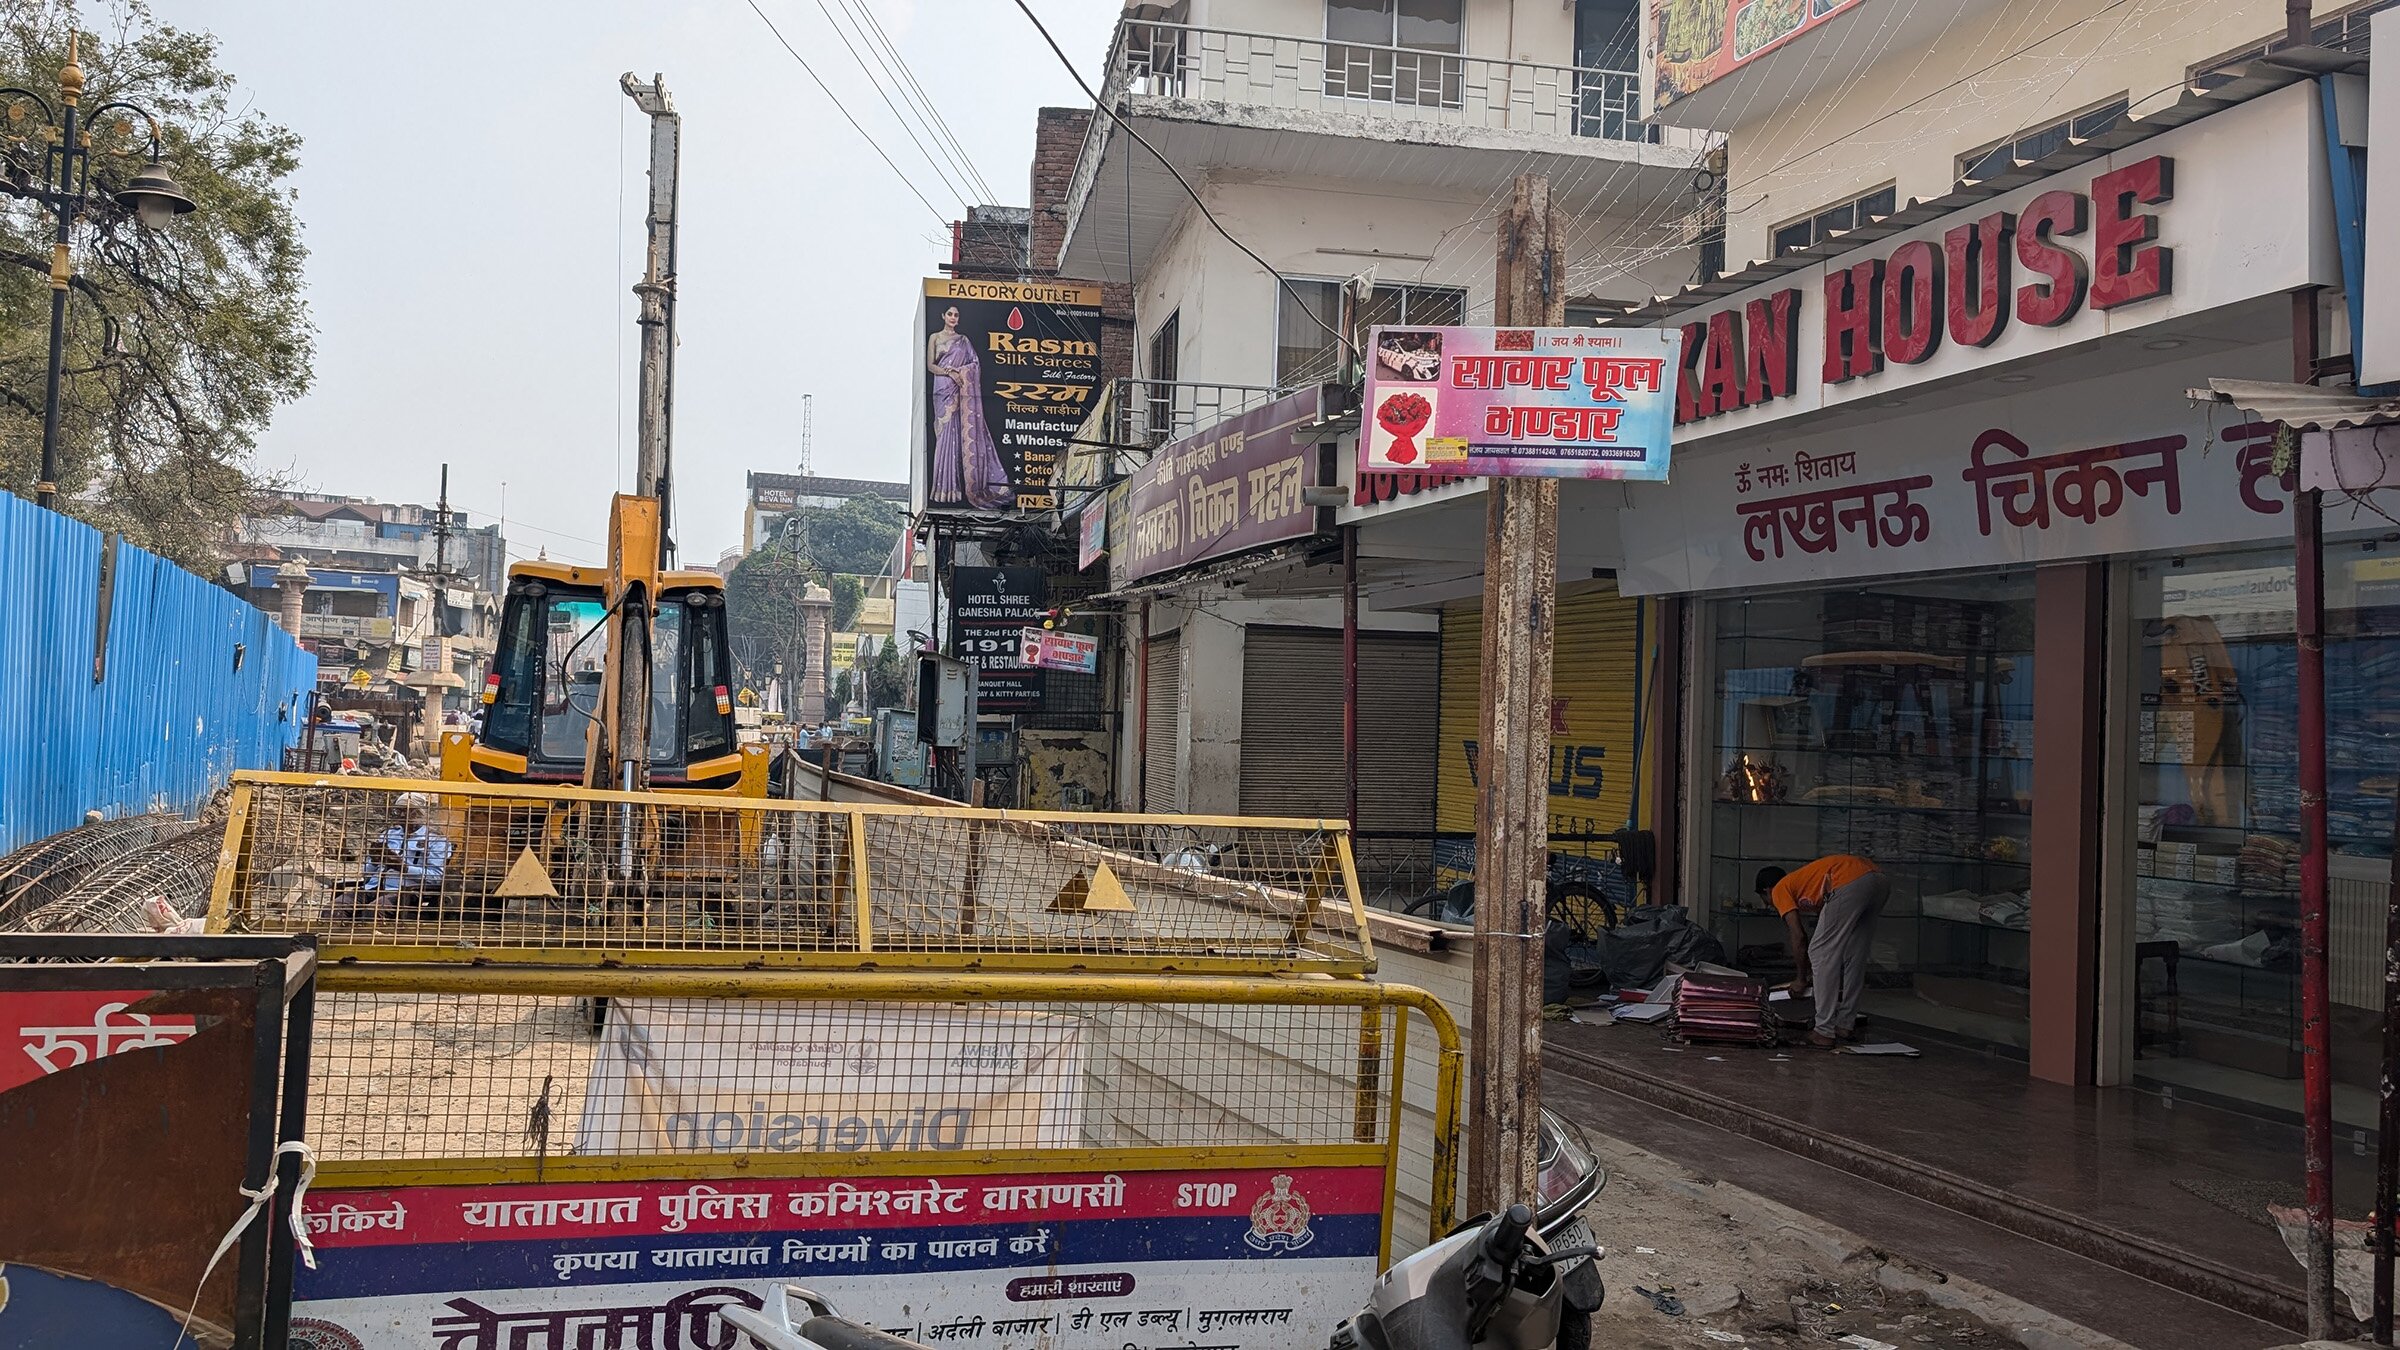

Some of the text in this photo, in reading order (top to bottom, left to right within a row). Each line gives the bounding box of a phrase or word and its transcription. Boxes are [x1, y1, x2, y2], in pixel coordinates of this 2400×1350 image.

[1822, 155, 2175, 385] HOUSE
[948, 284, 1081, 304] FACTORY OUTLET
[988, 331, 1097, 357] Rasm
[1551, 337, 1569, 347] जय
[1572, 334, 1585, 347] श्री
[995, 352, 1092, 369] Silk Sarees
[1042, 369, 1096, 382] Silk Factory
[1451, 356, 1665, 402] सागर फूल
[1006, 401, 1039, 416] सिल्क
[1485, 405, 1625, 442] भण्डार
[1002, 434, 1012, 445] &
[1484, 446, 1510, 455] जायसवाल
[1156, 454, 1174, 486] कीर्ति
[1219, 431, 1245, 459] एण्ड
[1756, 464, 1789, 489] नमः
[1794, 450, 1856, 484] शिवाय
[1188, 474, 1240, 544] चिकन
[1247, 455, 1304, 525] महल
[1736, 474, 1933, 562] लखनऊ
[1962, 428, 2188, 537] चिकन
[967, 594, 1030, 605] HOTEL SHREE
[958, 607, 1002, 617] GANESHA
[964, 629, 982, 637] THE
[984, 629, 1000, 637] 2nd
[981, 656, 987, 669] &
[462, 1196, 643, 1228] यातायात
[658, 1184, 772, 1233] पुलिस
[788, 1179, 968, 1218] कमिश्नरेट
[982, 1173, 1126, 1212] वाराणसी
[1177, 1182, 1237, 1208] STOP
[553, 1226, 1050, 1281] कृपया यातायात नियमों का पालन करें
[1019, 1276, 1123, 1299] हमारी शाखाएं
[928, 1314, 986, 1341] अर्दली
[992, 1317, 1053, 1337] बाजार
[1071, 1307, 1094, 1331] डी
[1100, 1309, 1129, 1331] एल
[1137, 1307, 1183, 1334] डब्ल्यू
